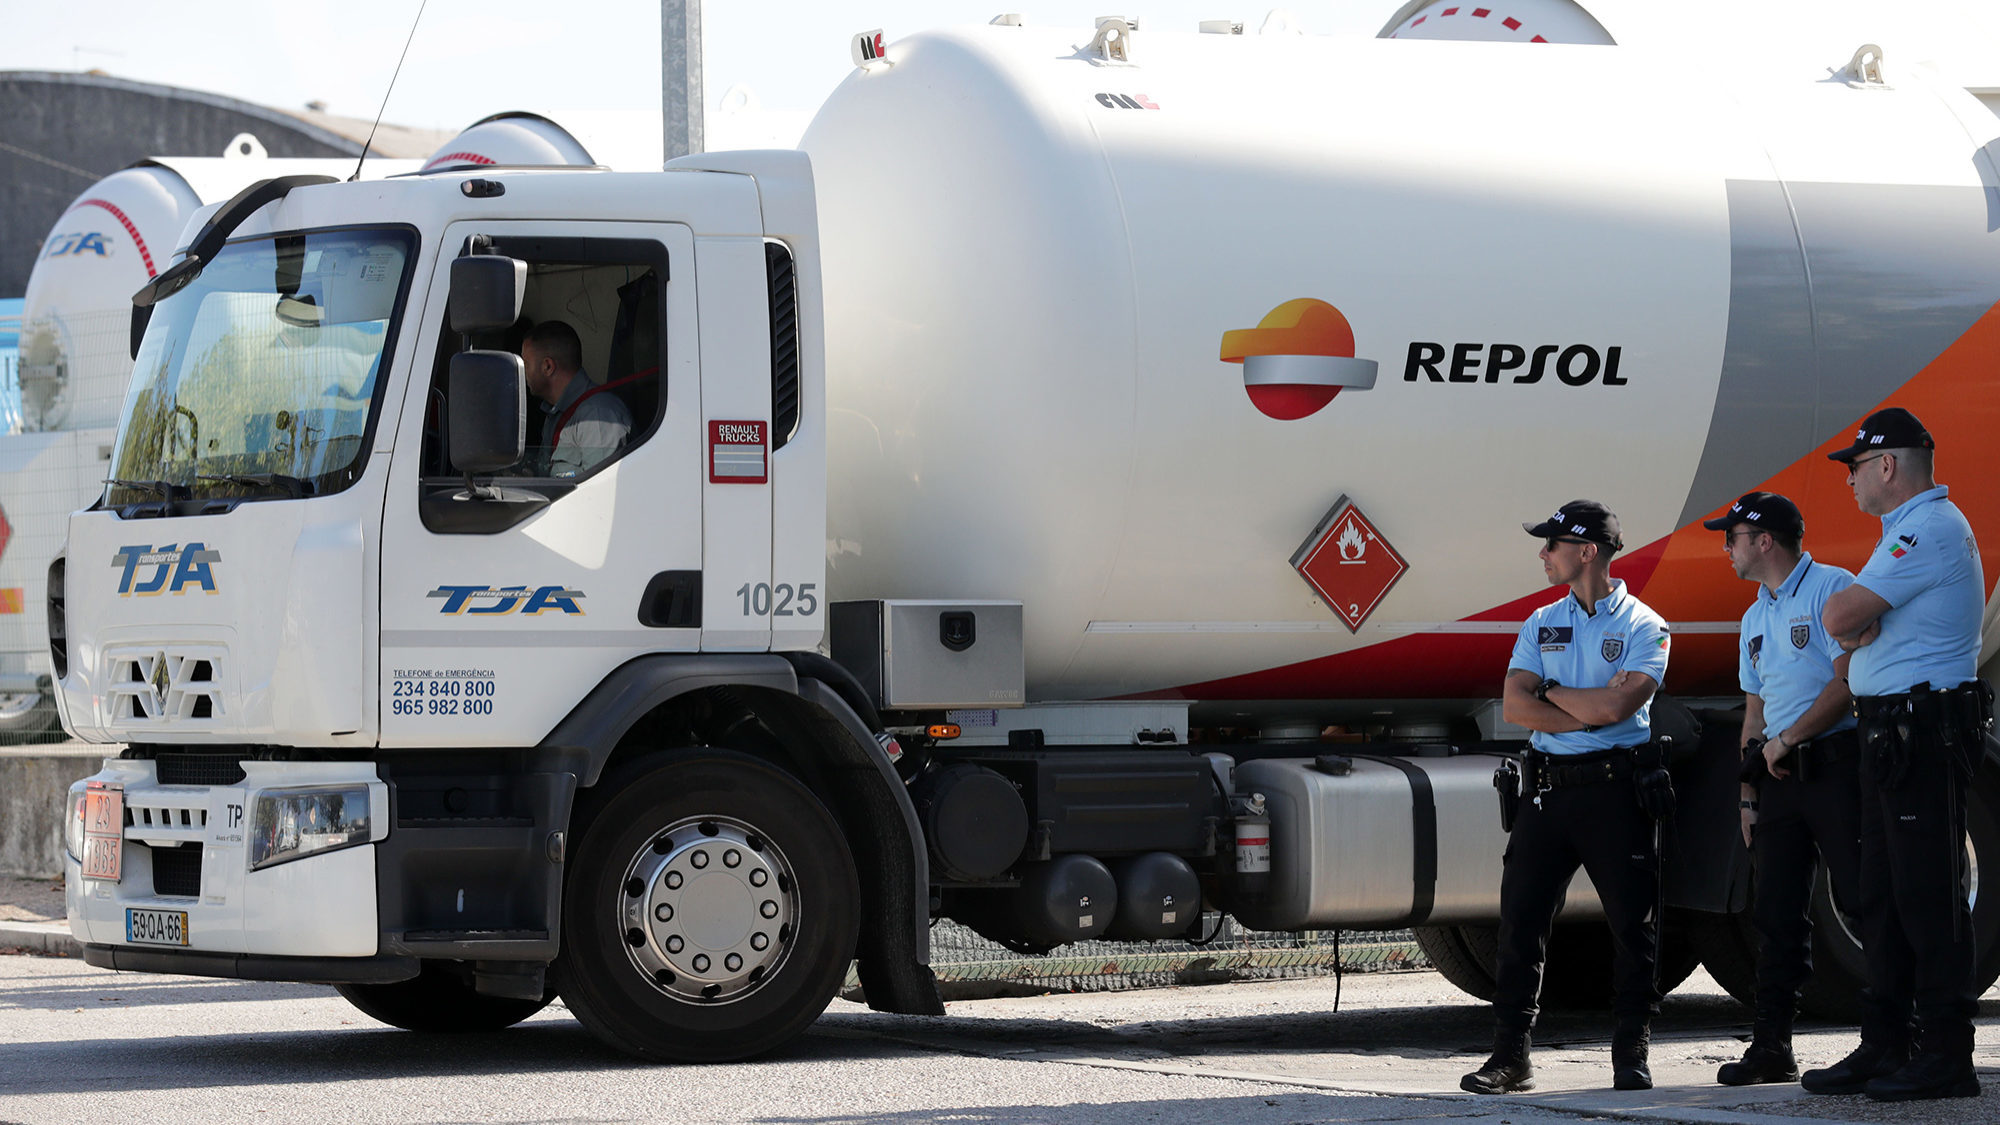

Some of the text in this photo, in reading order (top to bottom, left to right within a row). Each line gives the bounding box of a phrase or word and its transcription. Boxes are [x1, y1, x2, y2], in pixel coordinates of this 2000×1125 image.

[1403, 342, 1628, 386] REPSOL
[719, 424, 760, 434] RENAULT
[719, 433, 760, 443] TRUCKS
[736, 582, 818, 616] 1025
[1350, 603, 1359, 618] 2
[393, 668, 495, 678] TELEFONE de EMERGÊNCIA
[393, 681, 496, 697] 234 840 800
[392, 699, 493, 715] 965 982 800
[96, 795, 111, 829] 23
[227, 804, 243, 829] TP
[87, 838, 117, 874] 1965
